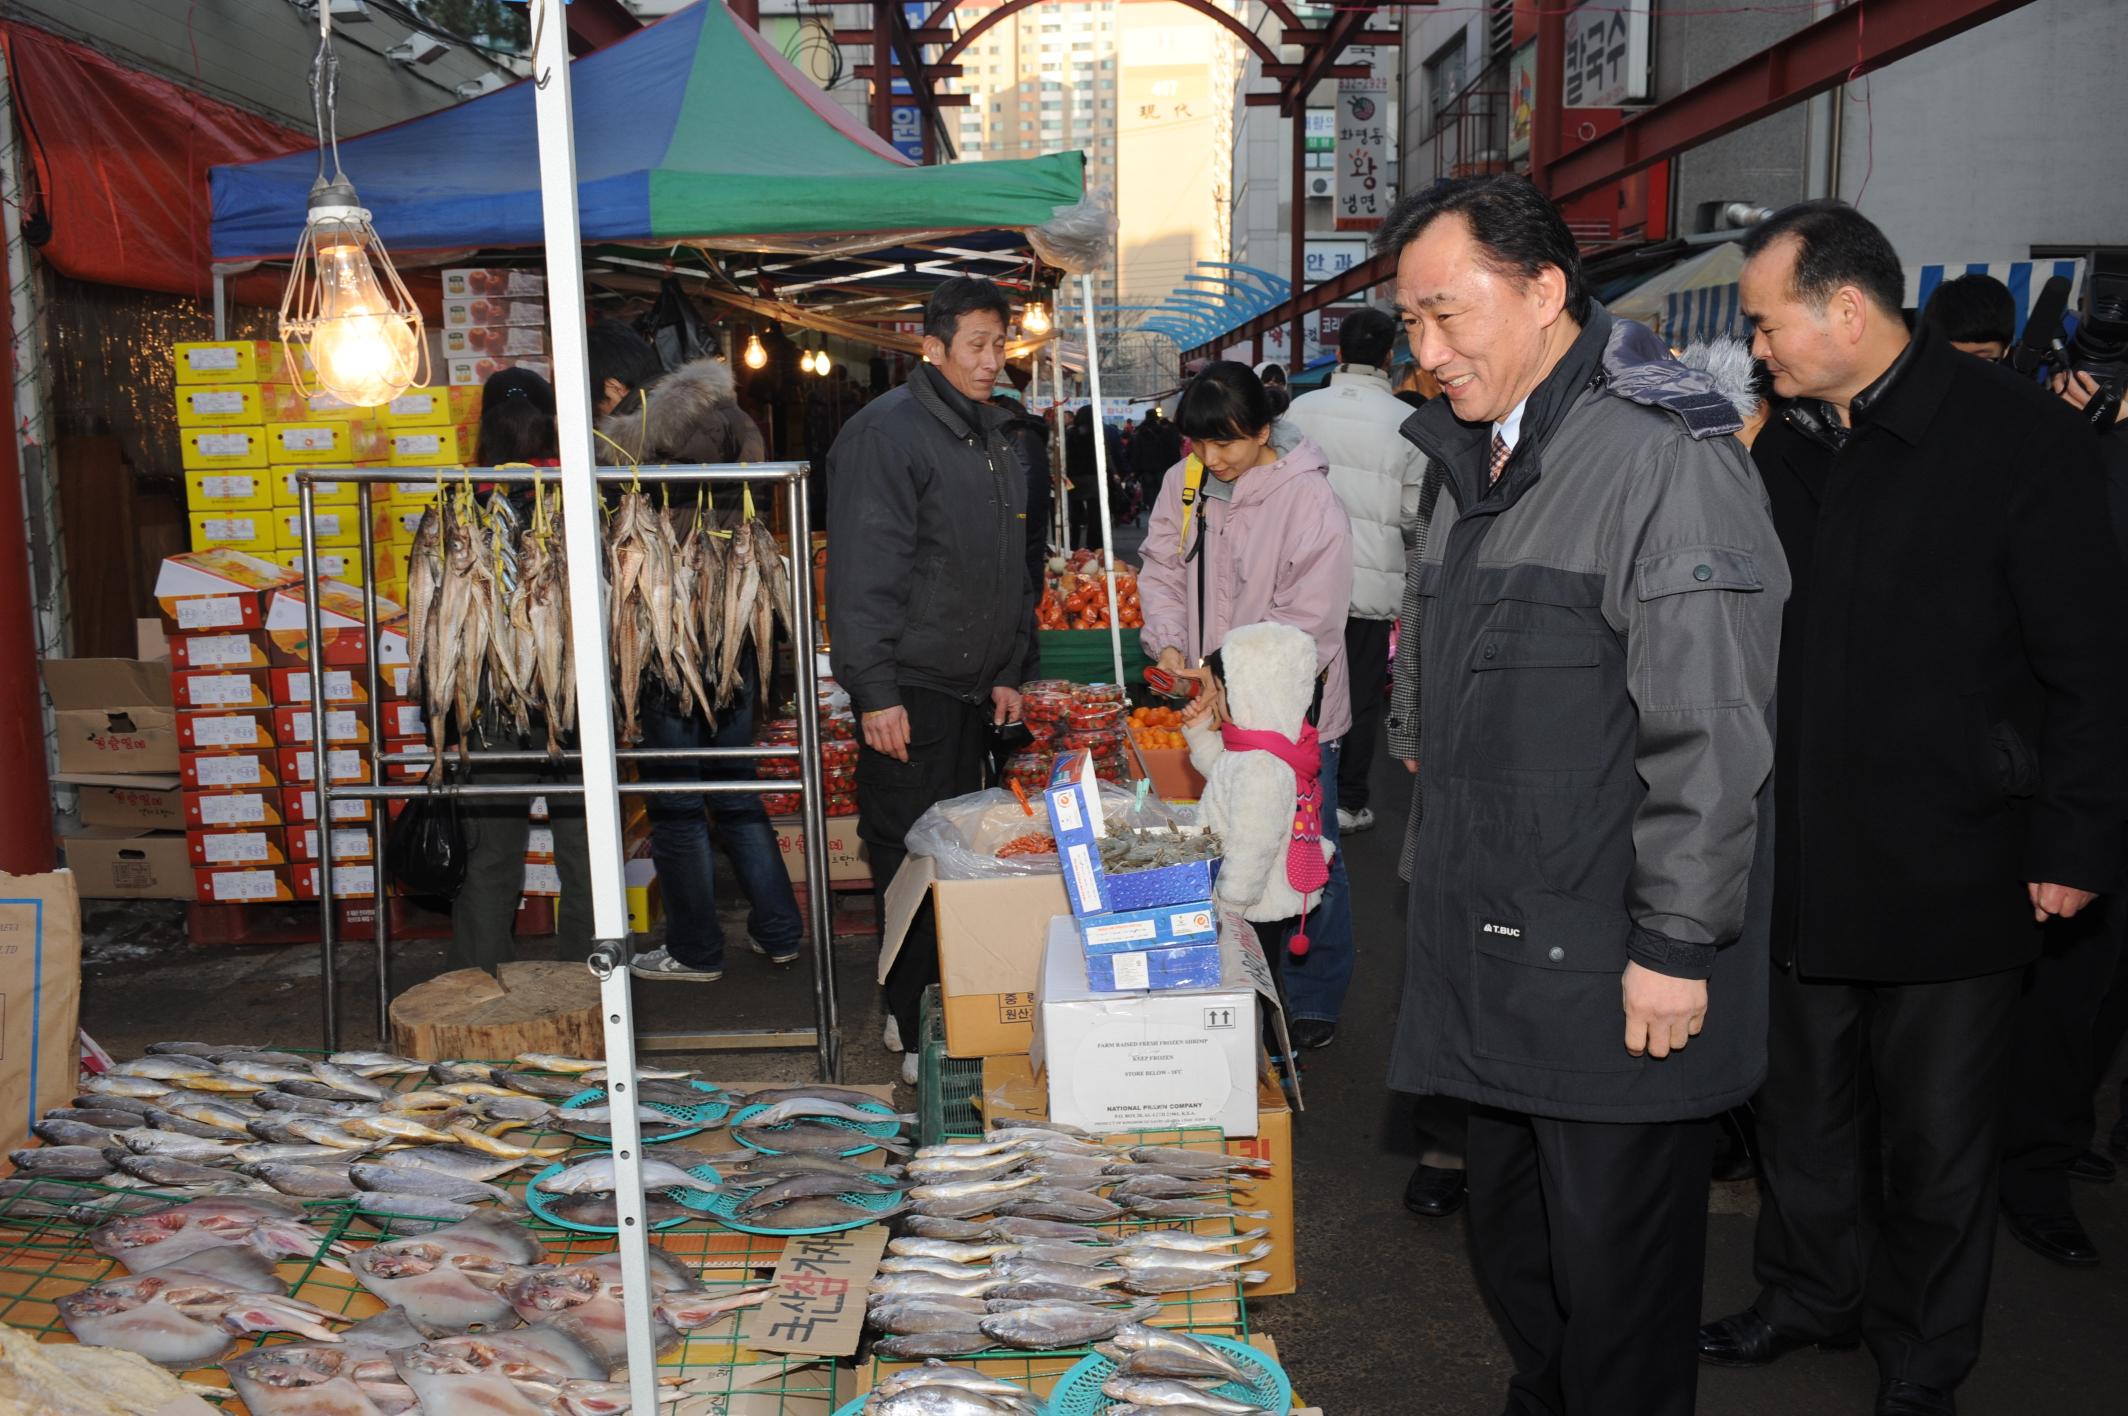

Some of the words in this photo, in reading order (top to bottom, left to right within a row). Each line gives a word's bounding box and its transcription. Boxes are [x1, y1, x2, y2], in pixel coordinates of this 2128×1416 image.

[1567, 9, 1626, 106] 칼국수
[1339, 128, 1384, 145] 화평동
[1350, 156, 1377, 190] 왕
[1342, 194, 1377, 214] 냉면
[1493, 925, 1520, 937] T.BUC
[1006, 1008, 1032, 1020] 원산
